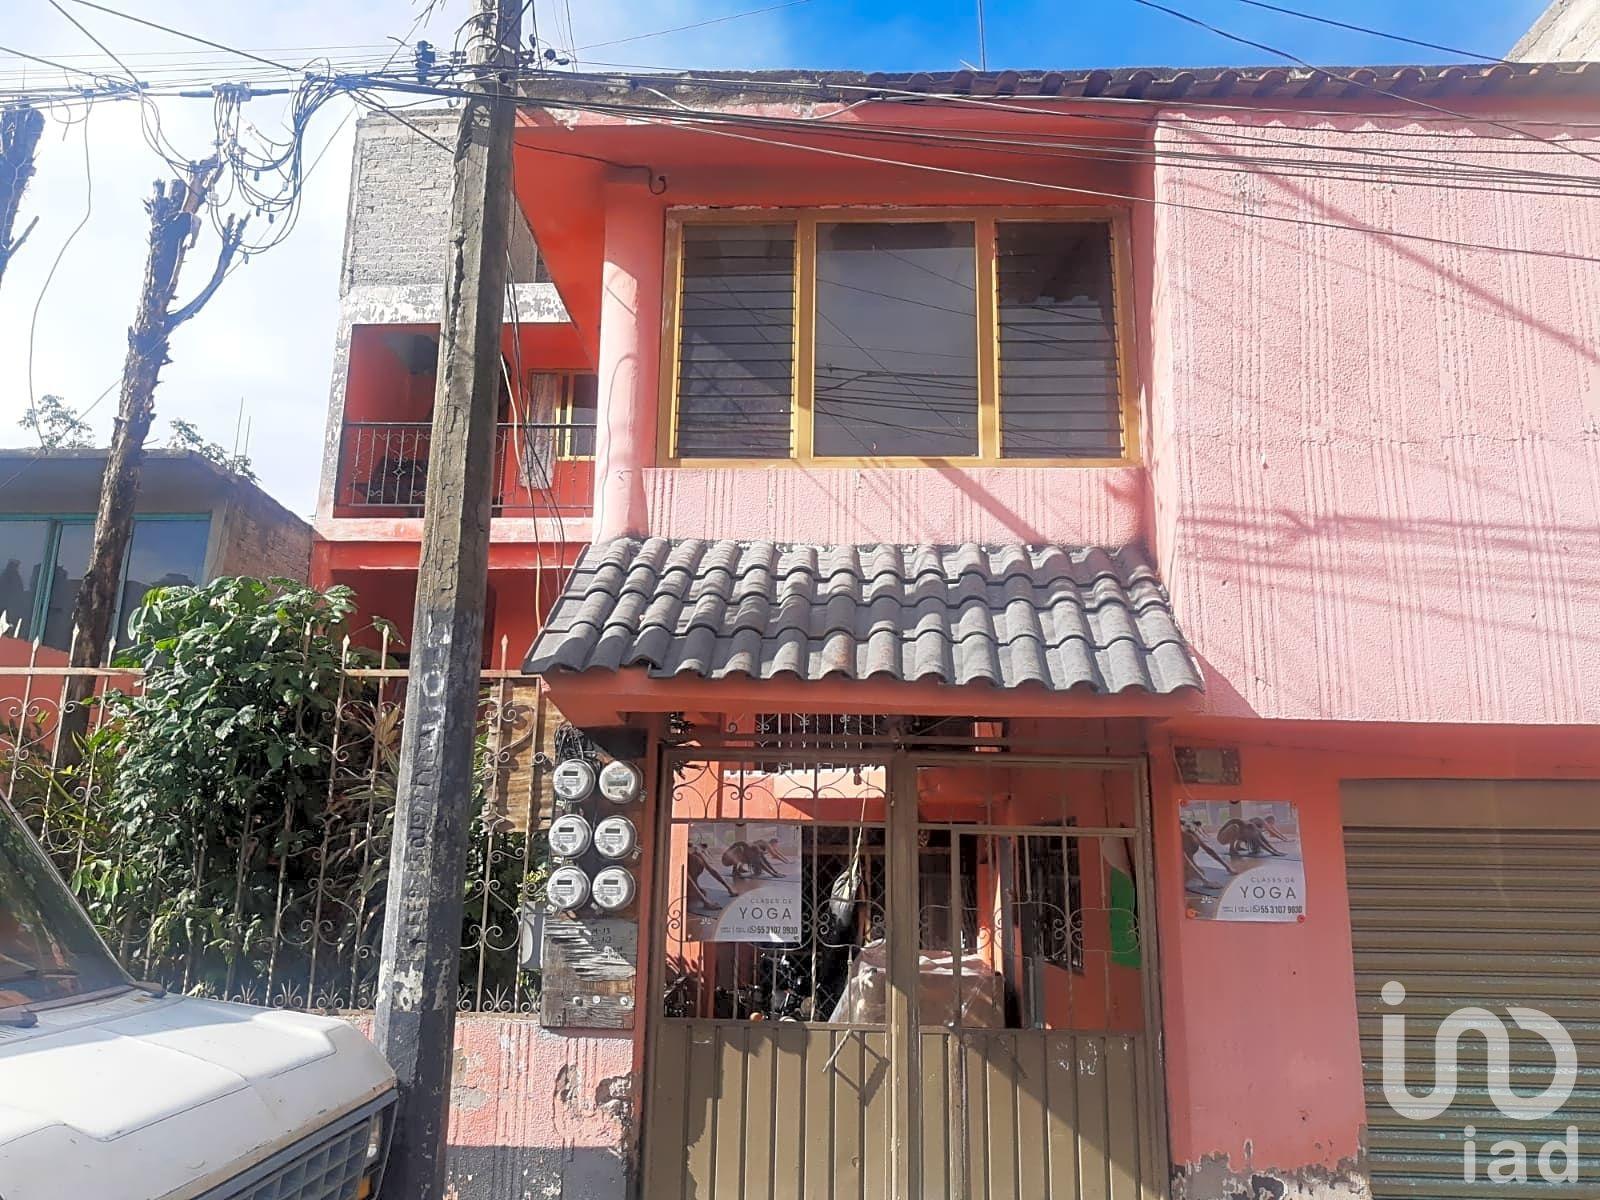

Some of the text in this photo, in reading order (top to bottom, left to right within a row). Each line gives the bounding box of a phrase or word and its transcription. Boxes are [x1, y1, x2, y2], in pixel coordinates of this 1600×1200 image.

[1240, 886, 1297, 899] YOGA
[739, 907, 792, 920] YOGA
[1260, 905, 1269, 914] 55
[1269, 905, 1286, 914] 3107
[757, 926, 765, 934] 55
[765, 926, 781, 934] 3107
